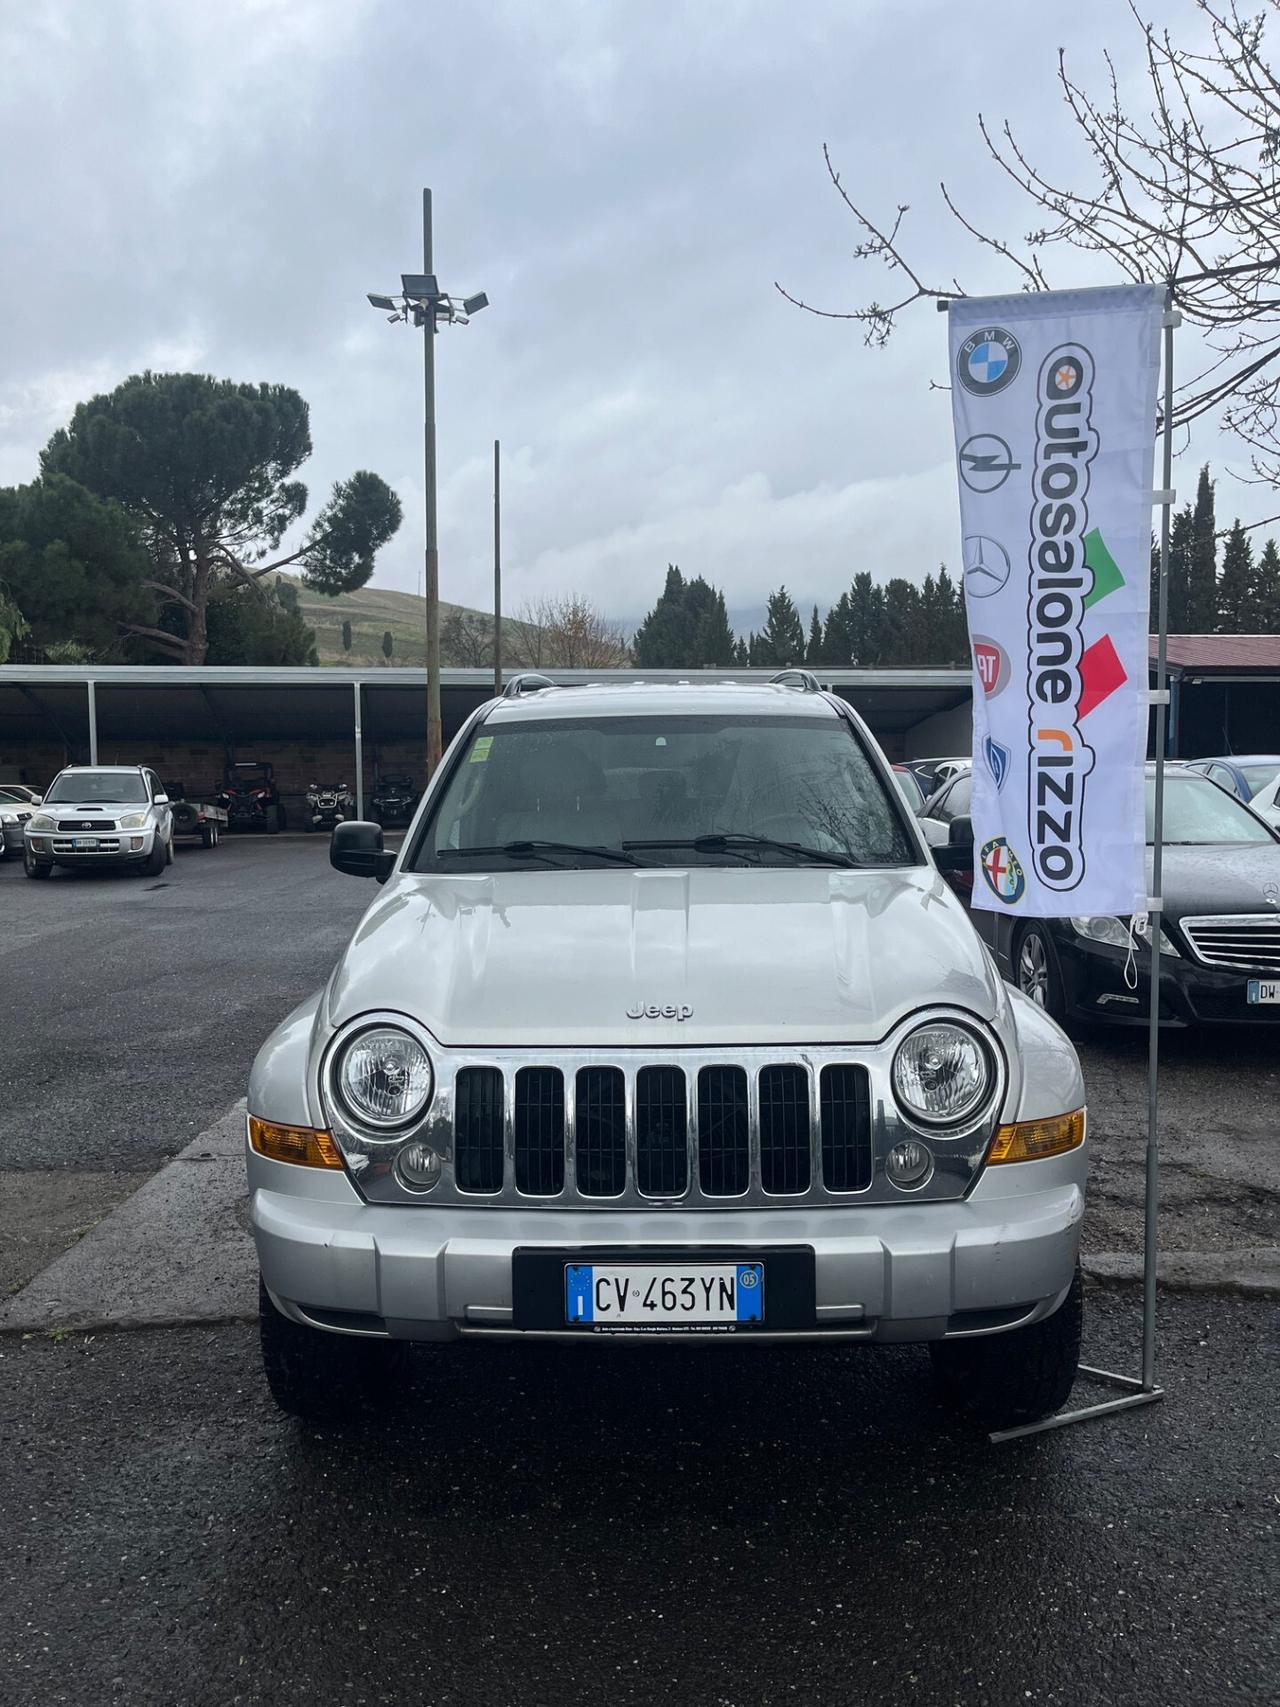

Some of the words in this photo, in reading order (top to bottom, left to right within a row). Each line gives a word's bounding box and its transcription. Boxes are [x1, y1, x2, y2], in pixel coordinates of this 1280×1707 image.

[964, 331, 1015, 352] BMW
[1036, 356, 1088, 704] autosalone
[977, 654, 996, 683] AT
[1037, 729, 1073, 880] rizzo
[626, 1000, 693, 1021] Jeep
[743, 1274, 755, 1285] 05
